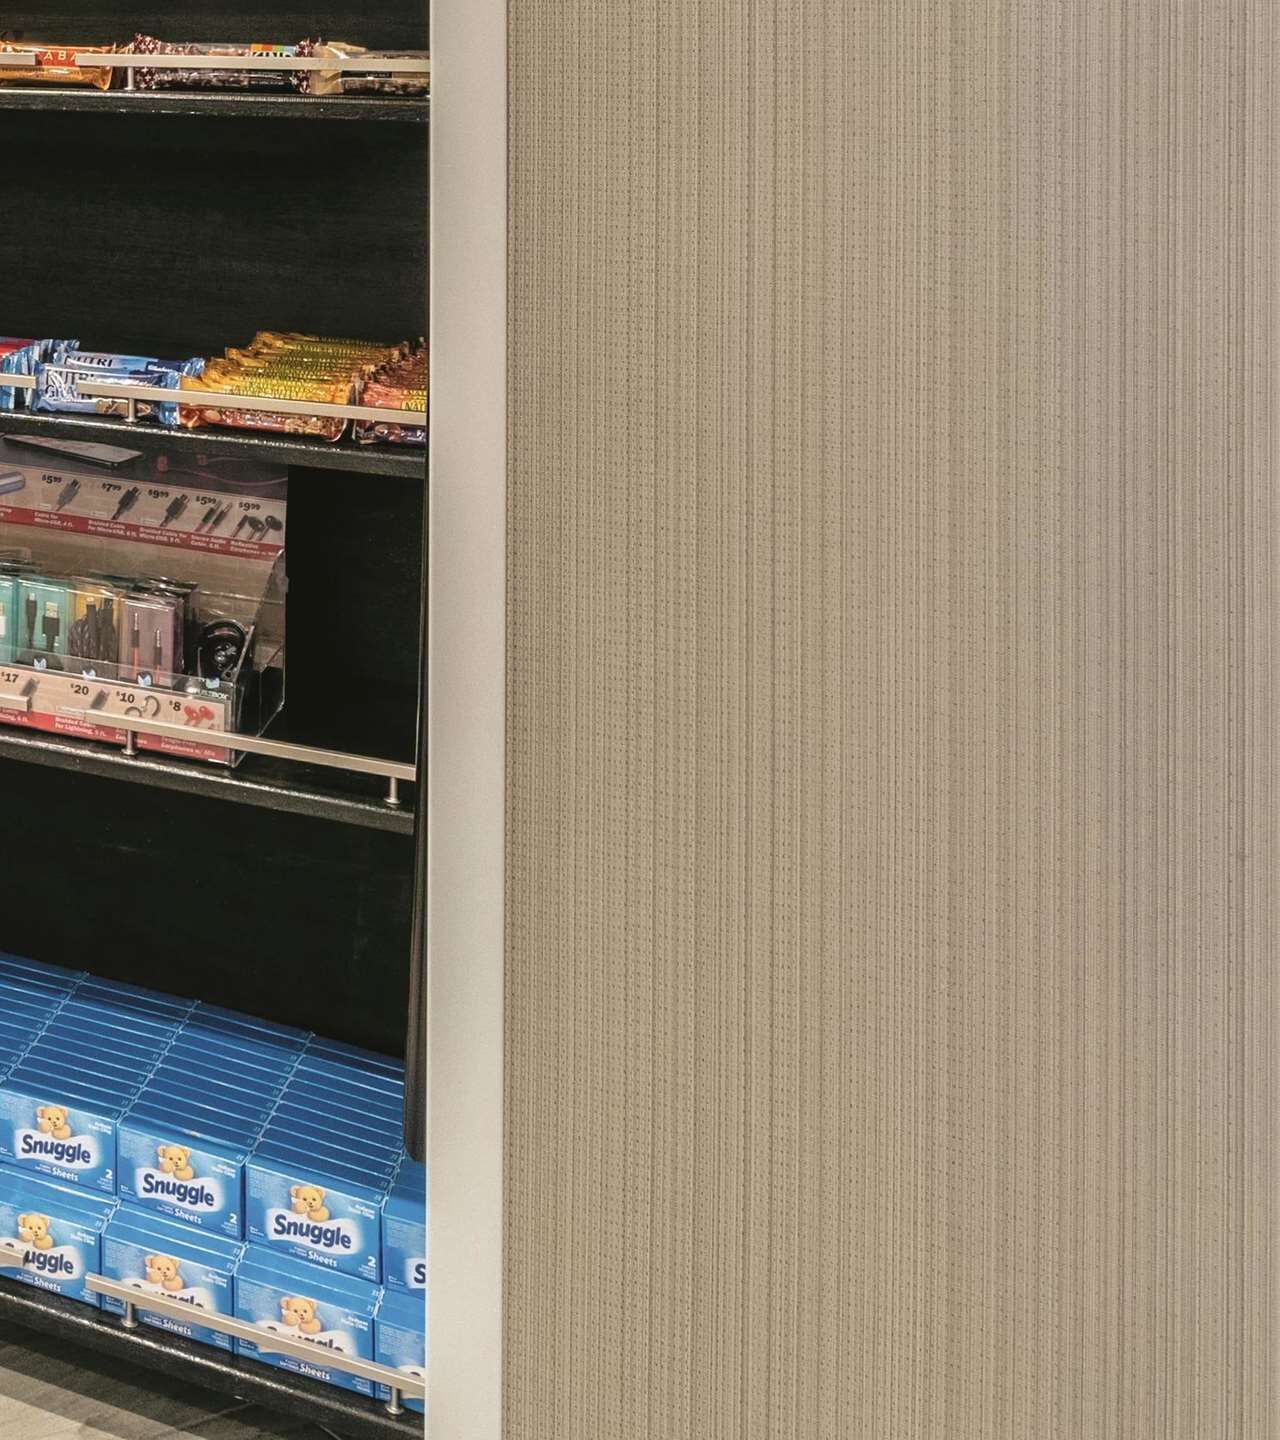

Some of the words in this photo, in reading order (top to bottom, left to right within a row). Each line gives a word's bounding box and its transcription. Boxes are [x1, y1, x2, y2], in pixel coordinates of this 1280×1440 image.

[1, 672, 19, 683] $17
[70, 683, 89, 695] $20
[116, 691, 135, 704] $10
[169, 700, 181, 711] $8
[21, 1134, 91, 1164] Snuggle
[52, 1167, 78, 1182] Sheets
[105, 1169, 113, 1179] 2
[142, 1174, 215, 1207] Snuggle
[174, 1209, 202, 1224] Sheets
[230, 1214, 237, 1224] 2
[273, 1214, 352, 1249] Snuggle
[308, 1250, 337, 1268] Sheets
[368, 1256, 376, 1268] 2
[33, 1277, 62, 1293] Sheets
[162, 1319, 192, 1337] Sheets
[299, 1362, 330, 1380] Sheets
